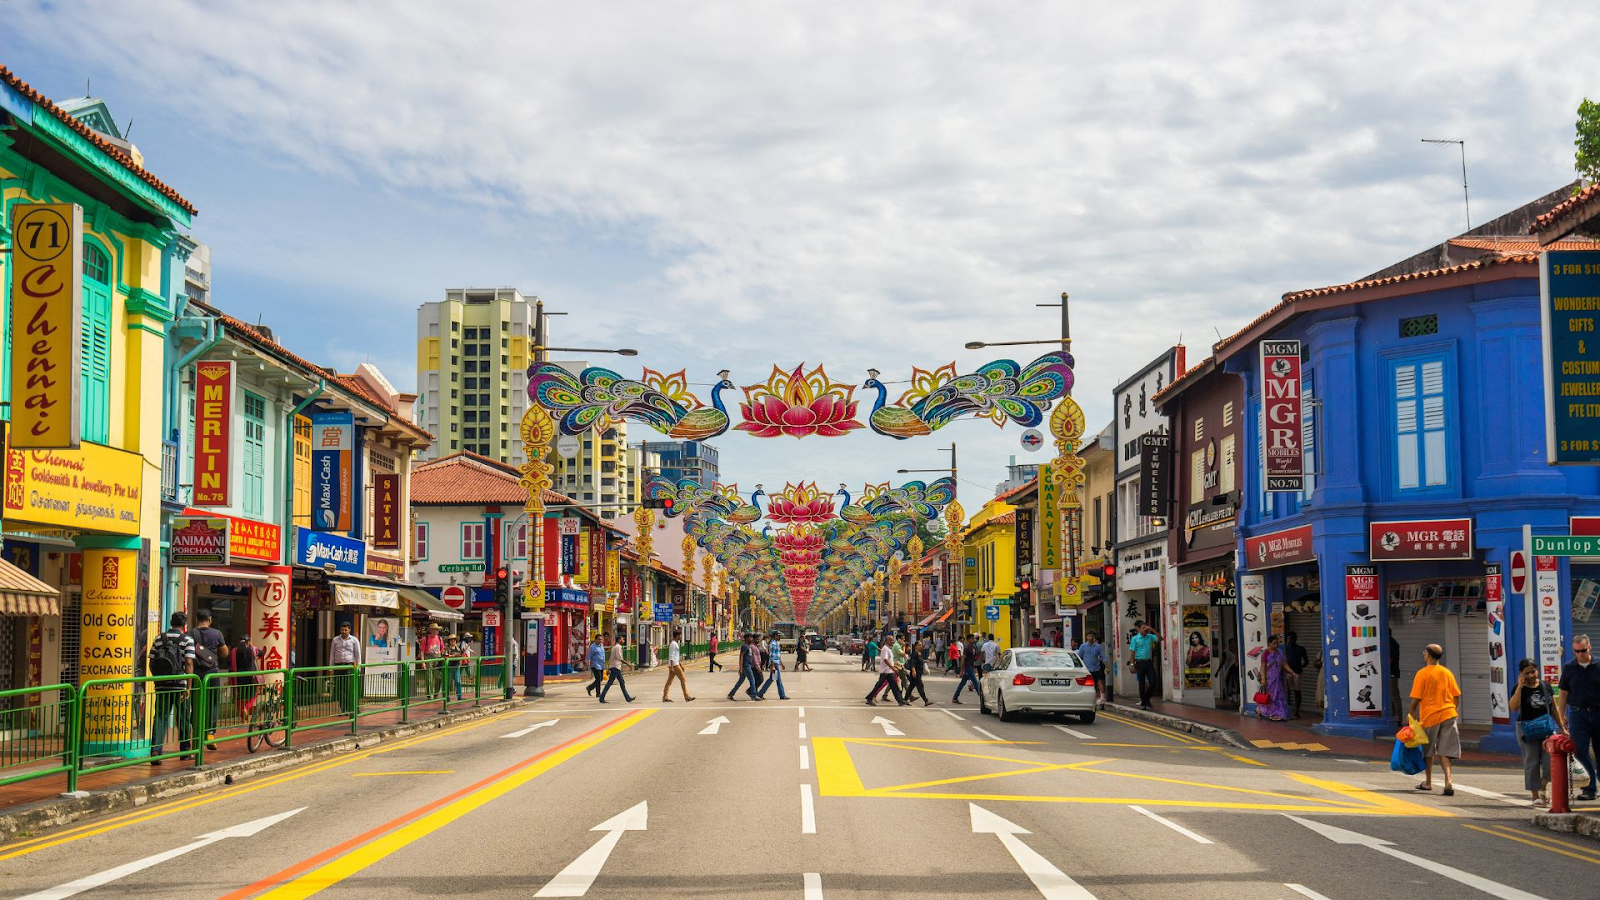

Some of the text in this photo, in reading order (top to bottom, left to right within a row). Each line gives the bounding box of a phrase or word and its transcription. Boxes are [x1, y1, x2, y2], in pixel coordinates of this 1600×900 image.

[26, 222, 60, 248] 71
[1554, 264, 1560, 275] 3
[1563, 264, 1582, 275] FOR
[1569, 318, 1594, 332] GIFTS
[21, 265, 64, 436] Chennai
[1265, 344, 1297, 354] MGM
[1578, 340, 1586, 354] &
[1266, 378, 1298, 449] MGR
[1569, 404, 1600, 418] PTE LTD
[201, 385, 222, 489] MERLIN
[1143, 437, 1169, 446] GMT
[1561, 440, 1568, 451] 3
[1570, 440, 1589, 451] FOR
[31, 467, 138, 499] Goldsmith & Jewellery Pte Ltd
[320, 455, 330, 508] Maxi-Cash
[1150, 448, 1160, 513] JEWELLERS
[1204, 470, 1218, 489] GMT
[1270, 479, 1298, 488] NO.70
[212, 493, 224, 501] 75
[1045, 466, 1053, 518] KOMALA
[383, 480, 392, 538] SATYA
[173, 536, 224, 546] ANIMANI
[1018, 514, 1030, 558] MEENA
[1407, 530, 1465, 541] MGR 電話
[317, 542, 343, 562] Maxi-Cash
[1536, 538, 1591, 553] Dunlop
[12, 546, 31, 572] 73
[86, 590, 133, 600] Chennai
[262, 583, 282, 601] 75
[544, 591, 556, 601] 81
[83, 614, 133, 627] Old Gold
[98, 632, 118, 640] For
[84, 647, 132, 659] $CASH
[81, 665, 132, 675] EXCHANGE
